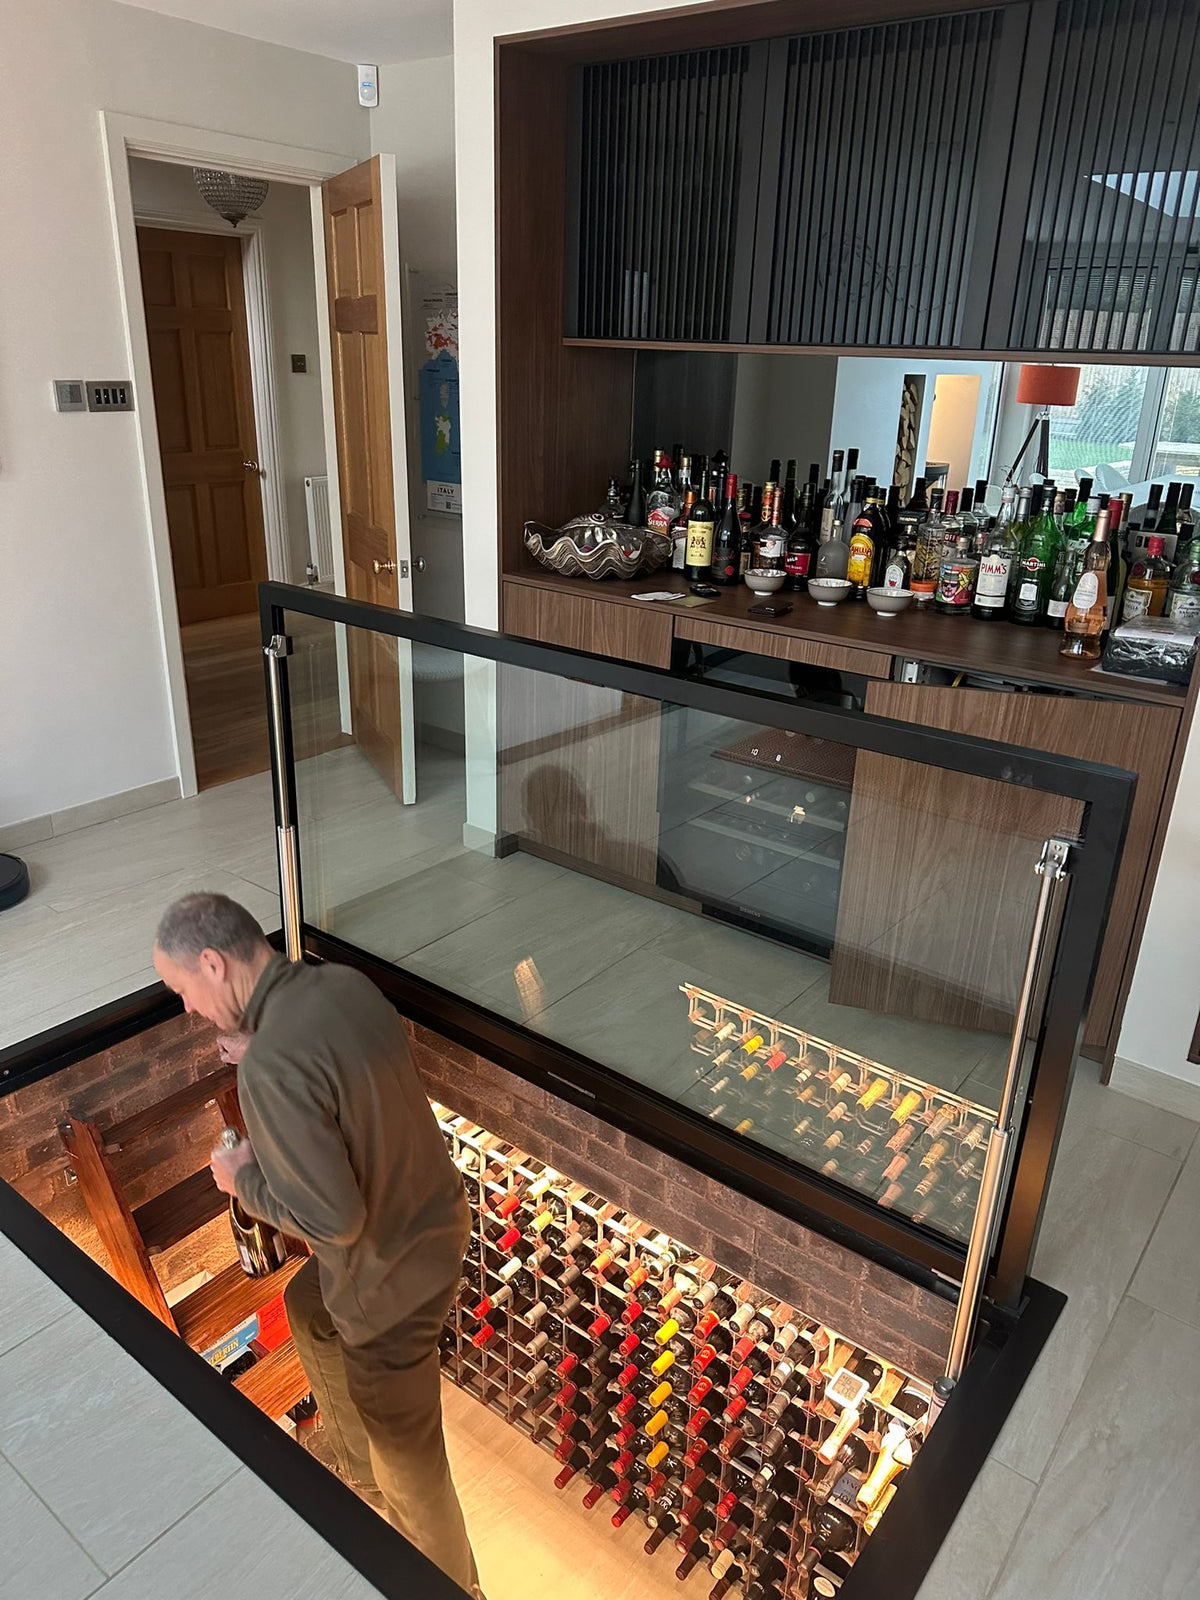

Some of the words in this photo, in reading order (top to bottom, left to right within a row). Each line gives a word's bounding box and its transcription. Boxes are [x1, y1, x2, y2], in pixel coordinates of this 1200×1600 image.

[437, 487, 455, 495] ITALY
[647, 519, 667, 527] SIERRA
[1022, 560, 1046, 568] MARTINI
[980, 562, 1007, 575] PIMM'S
